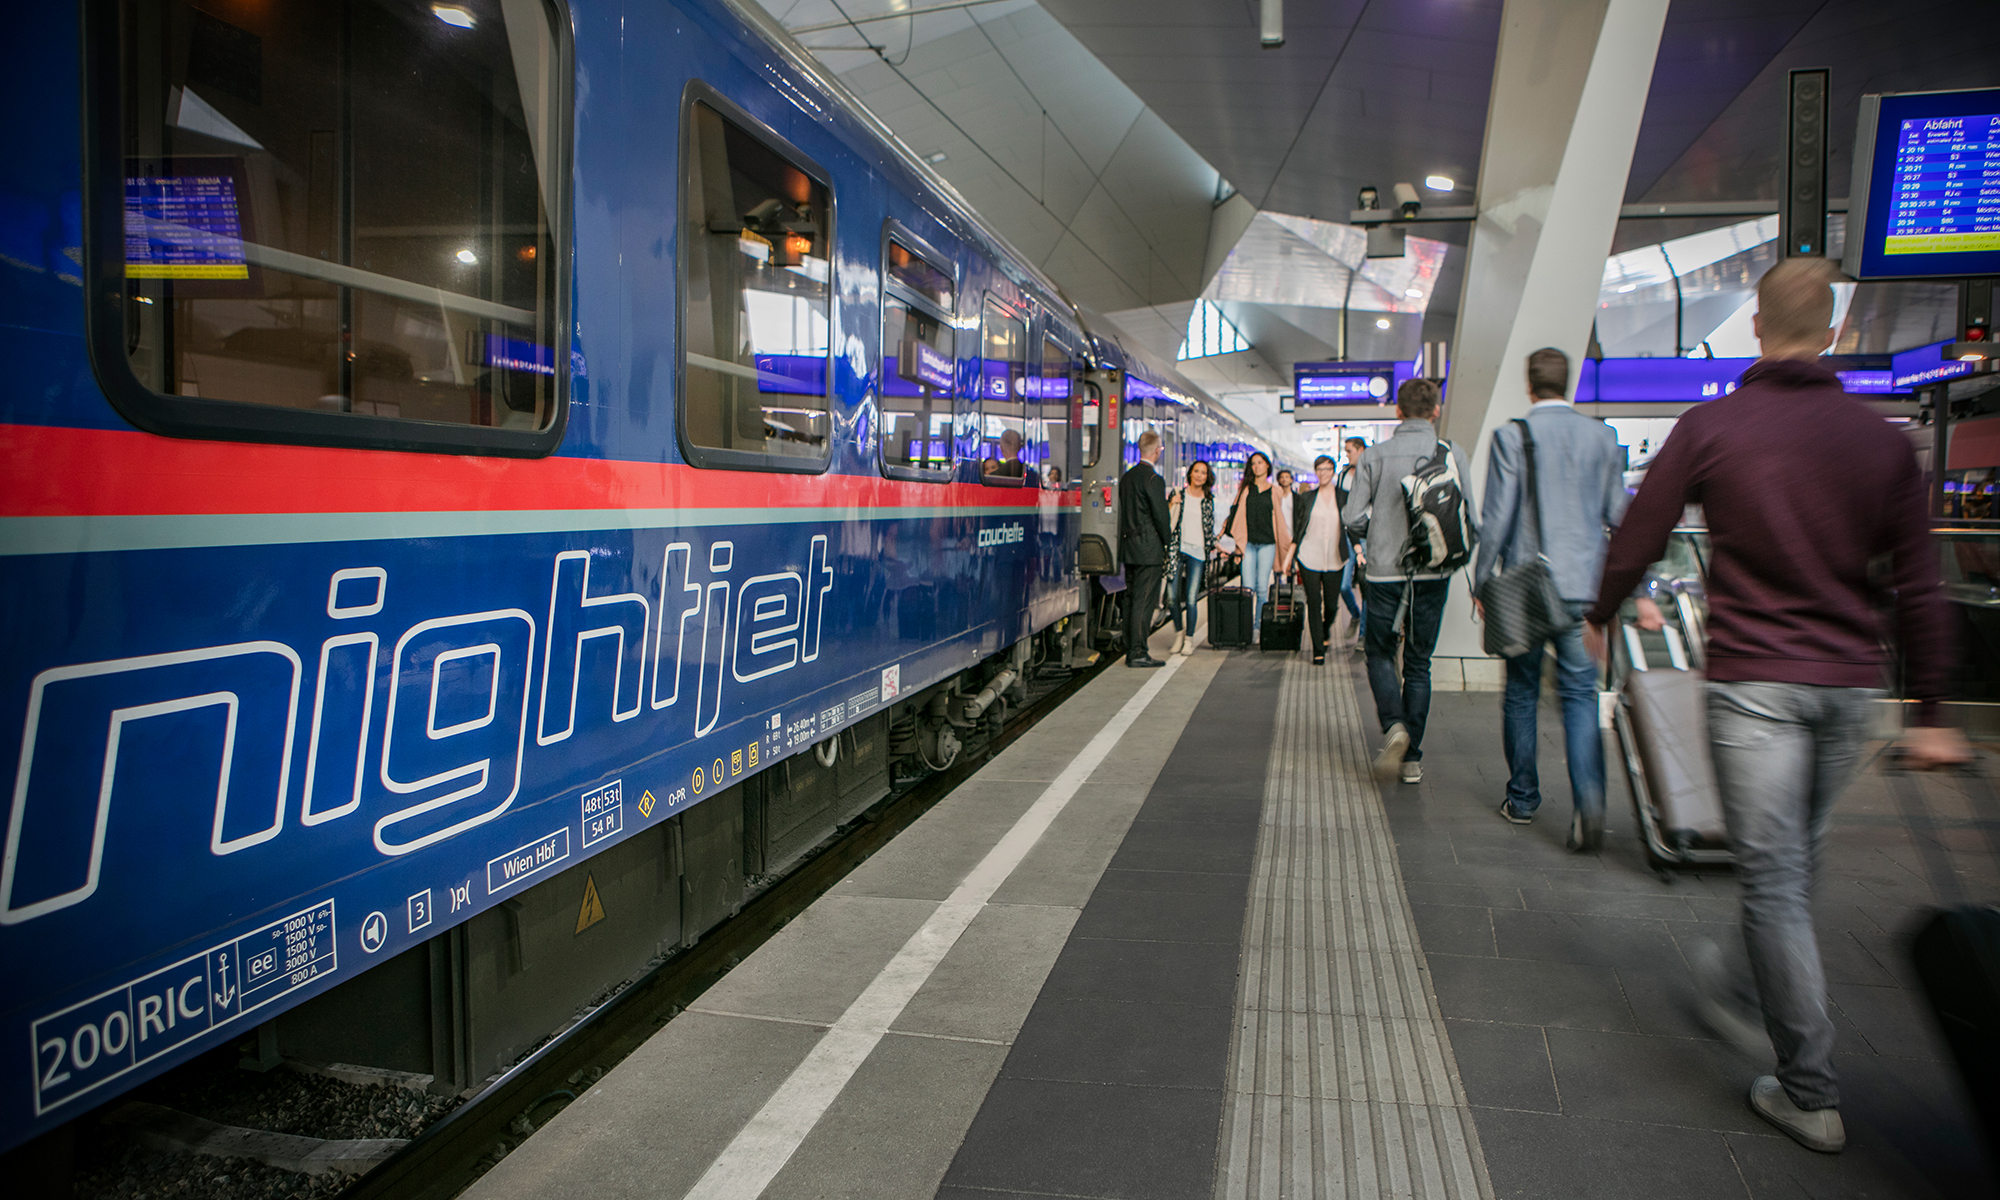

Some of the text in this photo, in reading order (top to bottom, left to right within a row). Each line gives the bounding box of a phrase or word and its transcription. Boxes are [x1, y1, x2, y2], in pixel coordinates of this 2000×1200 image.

[1923, 119, 1964, 130] Abfahrt
[1906, 155, 1924, 163] 2020
[1898, 210, 1917, 218] 2032
[978, 522, 1024, 548] couchette
[0, 535, 834, 926] nightjet
[696, 774, 701, 788] D
[585, 788, 620, 814] 48t 53t
[643, 797, 649, 811] R
[503, 839, 556, 879] Wien Hbf
[415, 901, 425, 921] 3
[283, 916, 306, 934] 1000
[308, 912, 315, 923] V
[285, 928, 307, 946] 1500
[308, 924, 315, 935] V
[285, 936, 316, 958] 1500 V
[252, 954, 273, 975] ee
[285, 948, 317, 971] 3000 V
[291, 964, 318, 985] 800 A
[138, 975, 205, 1043] RIC
[40, 1010, 130, 1092] 200
